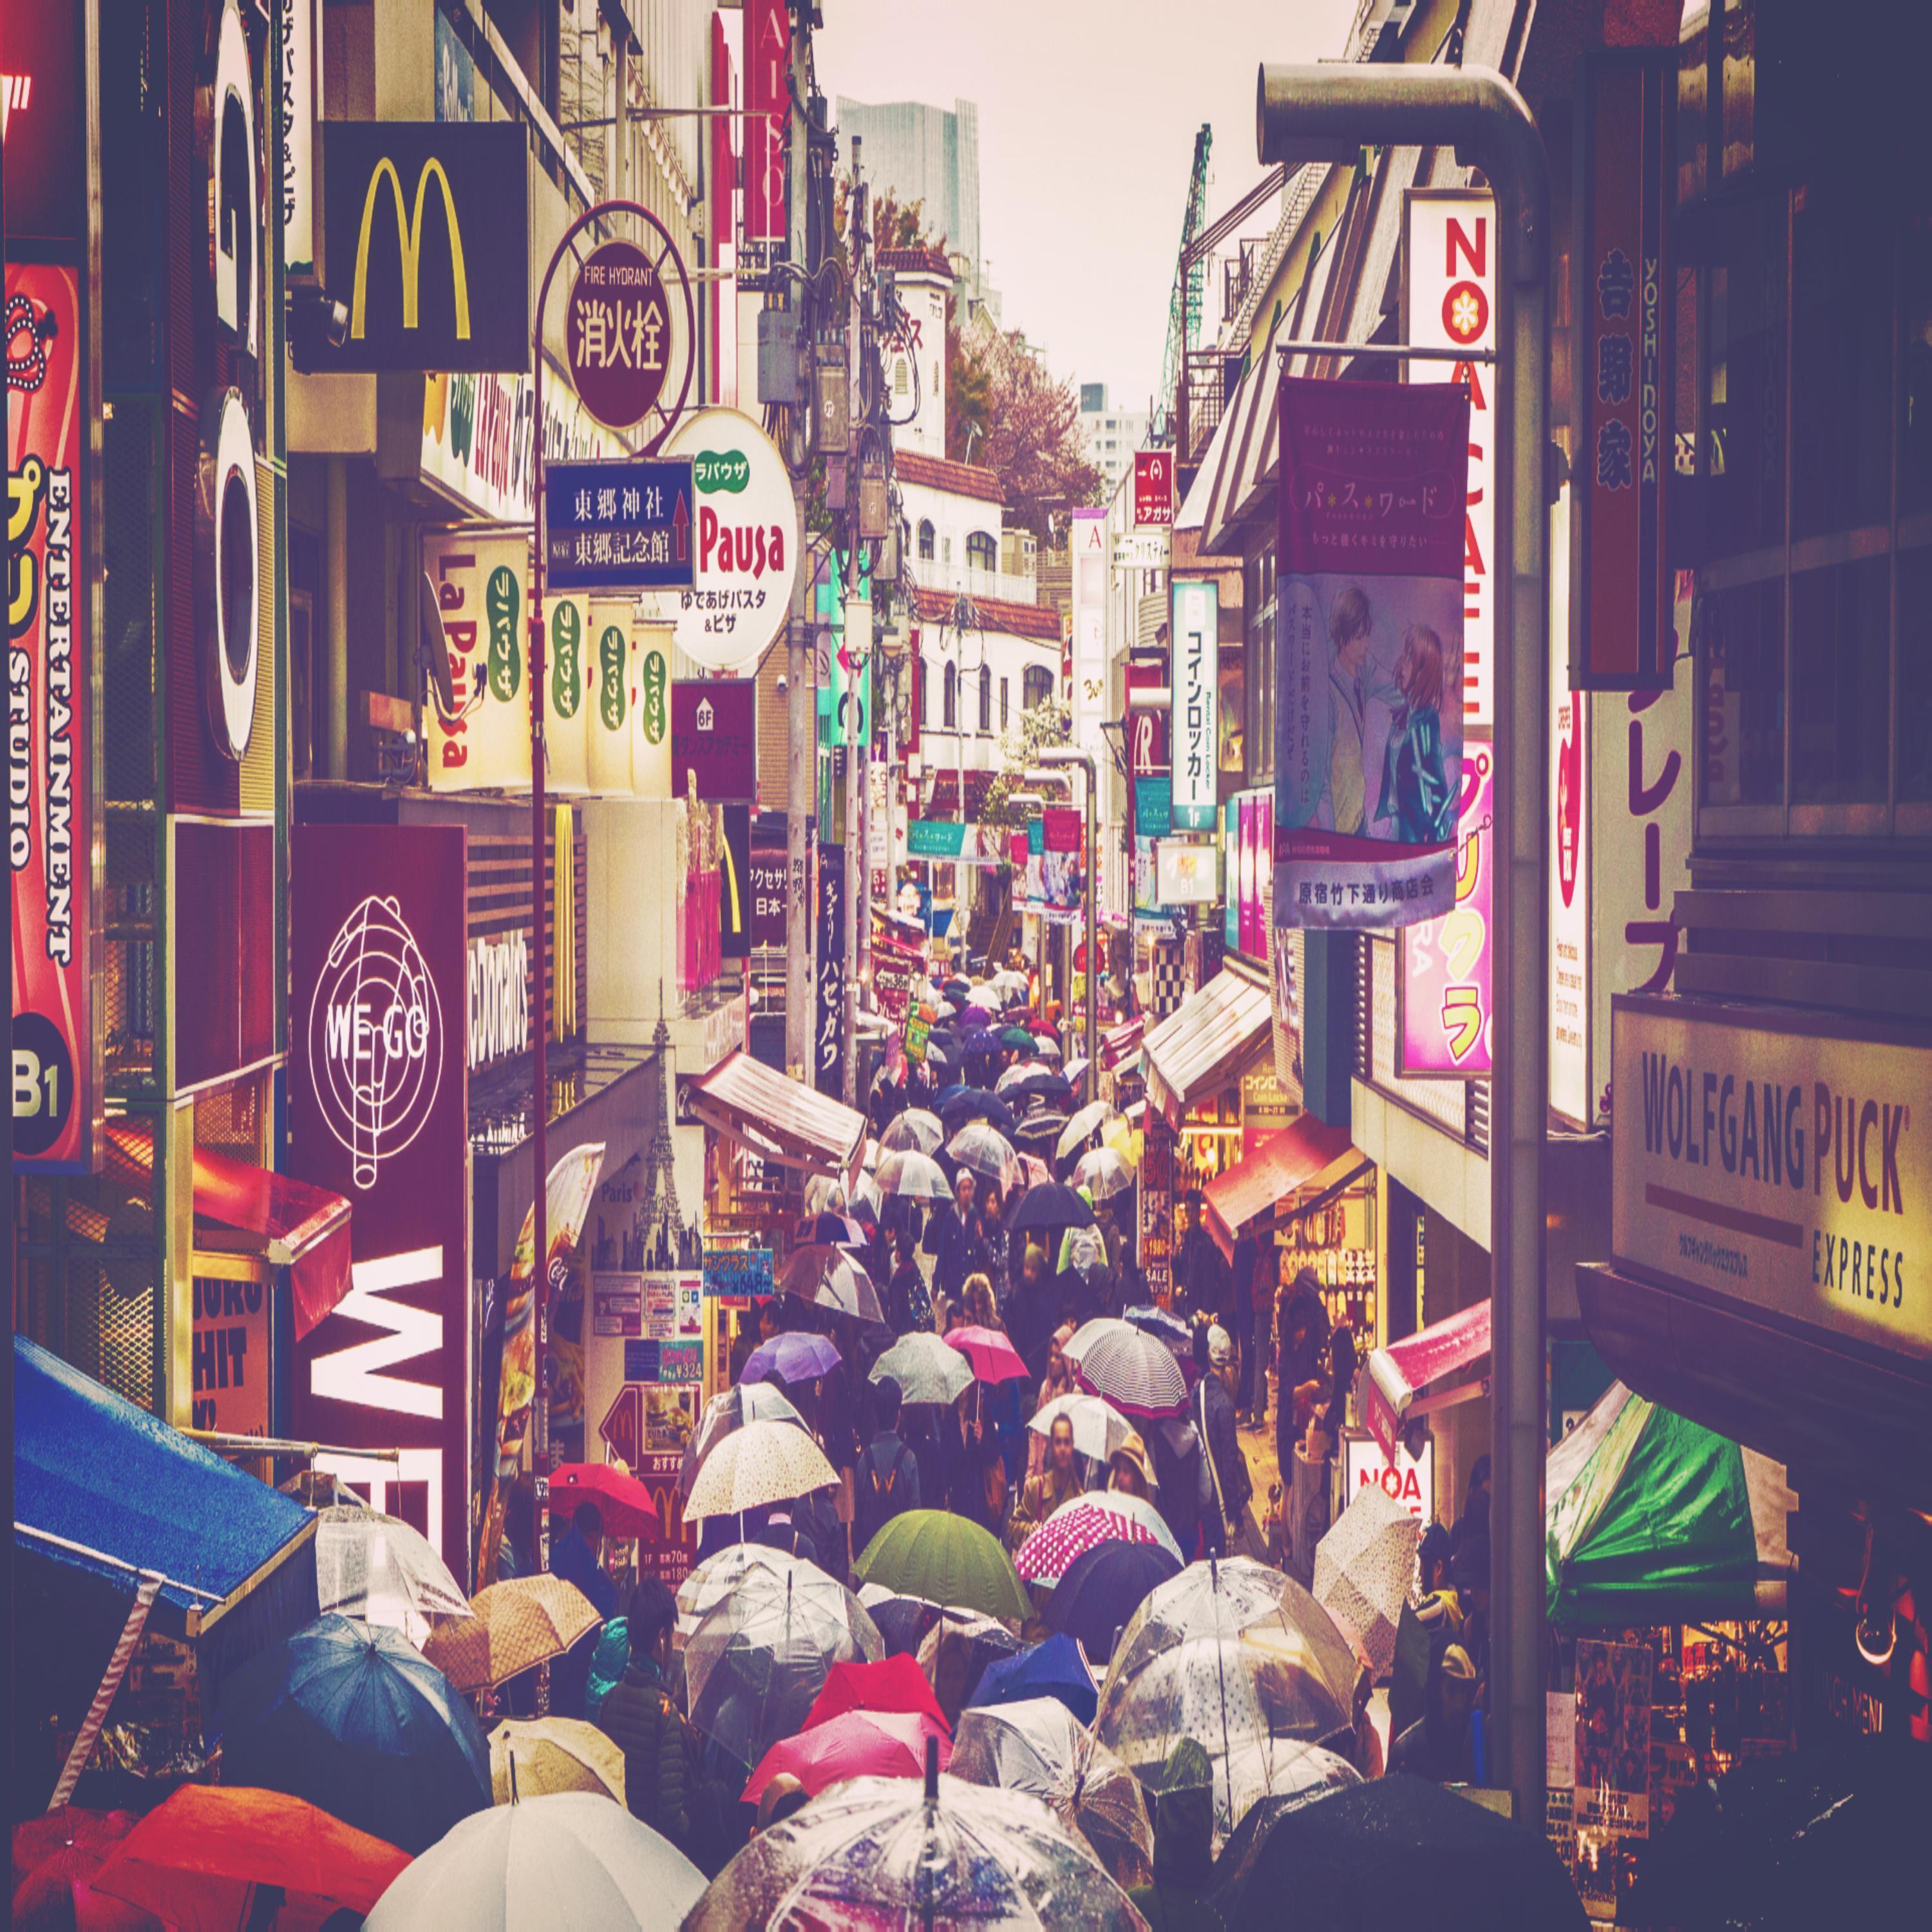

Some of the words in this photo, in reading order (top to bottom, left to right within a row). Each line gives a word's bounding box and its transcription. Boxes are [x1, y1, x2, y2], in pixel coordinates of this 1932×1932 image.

[584, 265, 605, 285] FIRE
[609, 266, 654, 287] HYDRANT
[576, 299, 663, 370] 消火栓
[574, 486, 665, 522] 東郷神社
[574, 531, 669, 566] 東郷記念館
[49, 471, 71, 964] ENTERTAINMENT
[697, 709, 712, 727] 6F
[1188, 632, 1202, 800] コインロッカー
[10, 652, 30, 868] STUDIO
[1298, 873, 1434, 905] 原宿竹下通り商店会
[468, 929, 528, 1071] cDonald's
[819, 960, 842, 1072] ハセガワ
[12, 1048, 58, 1117] B1
[1642, 1051, 1805, 1190] WOLFGANG
[1814, 1081, 1904, 1216] PUCK
[601, 1180, 633, 1203] Paris
[703, 1254, 749, 1273] サングラス
[1146, 1269, 1168, 1282] SALE
[1812, 1229, 1904, 1309] EXPRESS
[676, 1362, 702, 1379] ¥324
